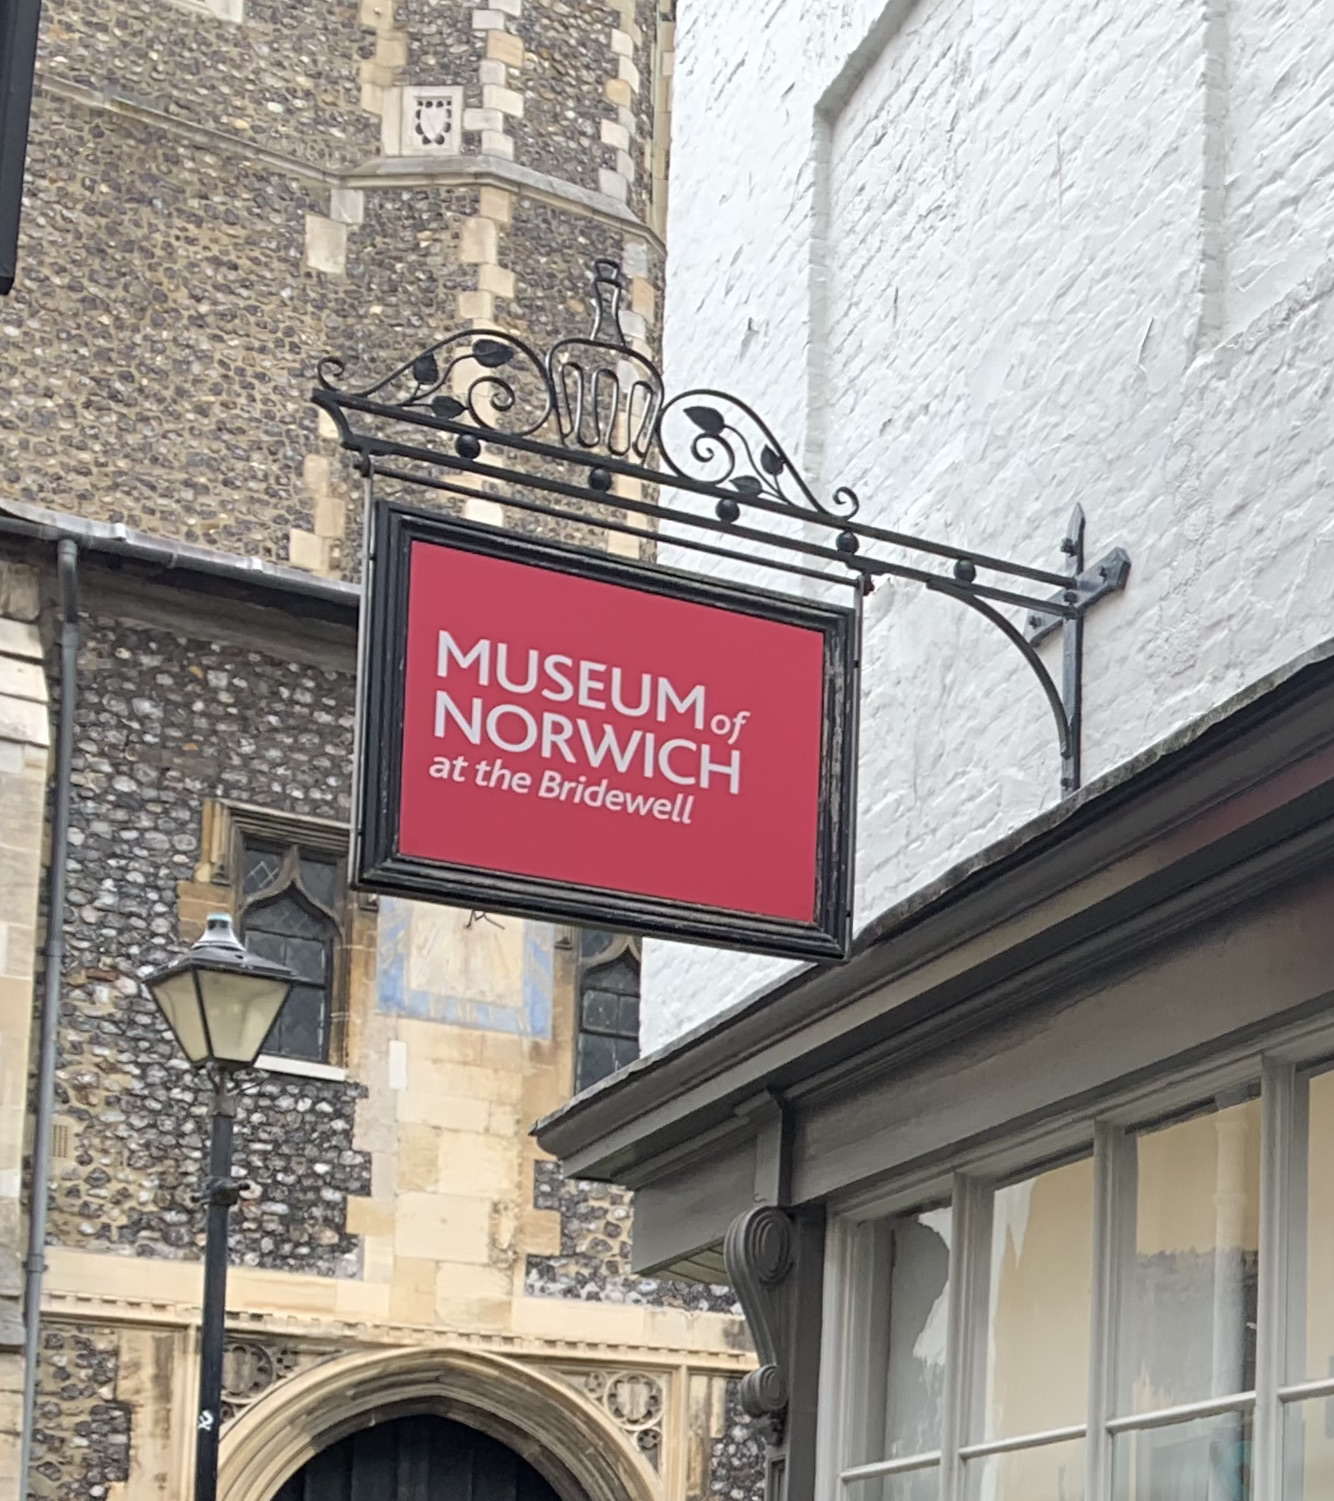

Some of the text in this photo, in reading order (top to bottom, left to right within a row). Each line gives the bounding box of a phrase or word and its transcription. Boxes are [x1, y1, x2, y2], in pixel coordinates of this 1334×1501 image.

[437, 630, 751, 745] MUSEUM of
[429, 755, 694, 824] at the Bridewell
[434, 690, 740, 795] NORWICH
